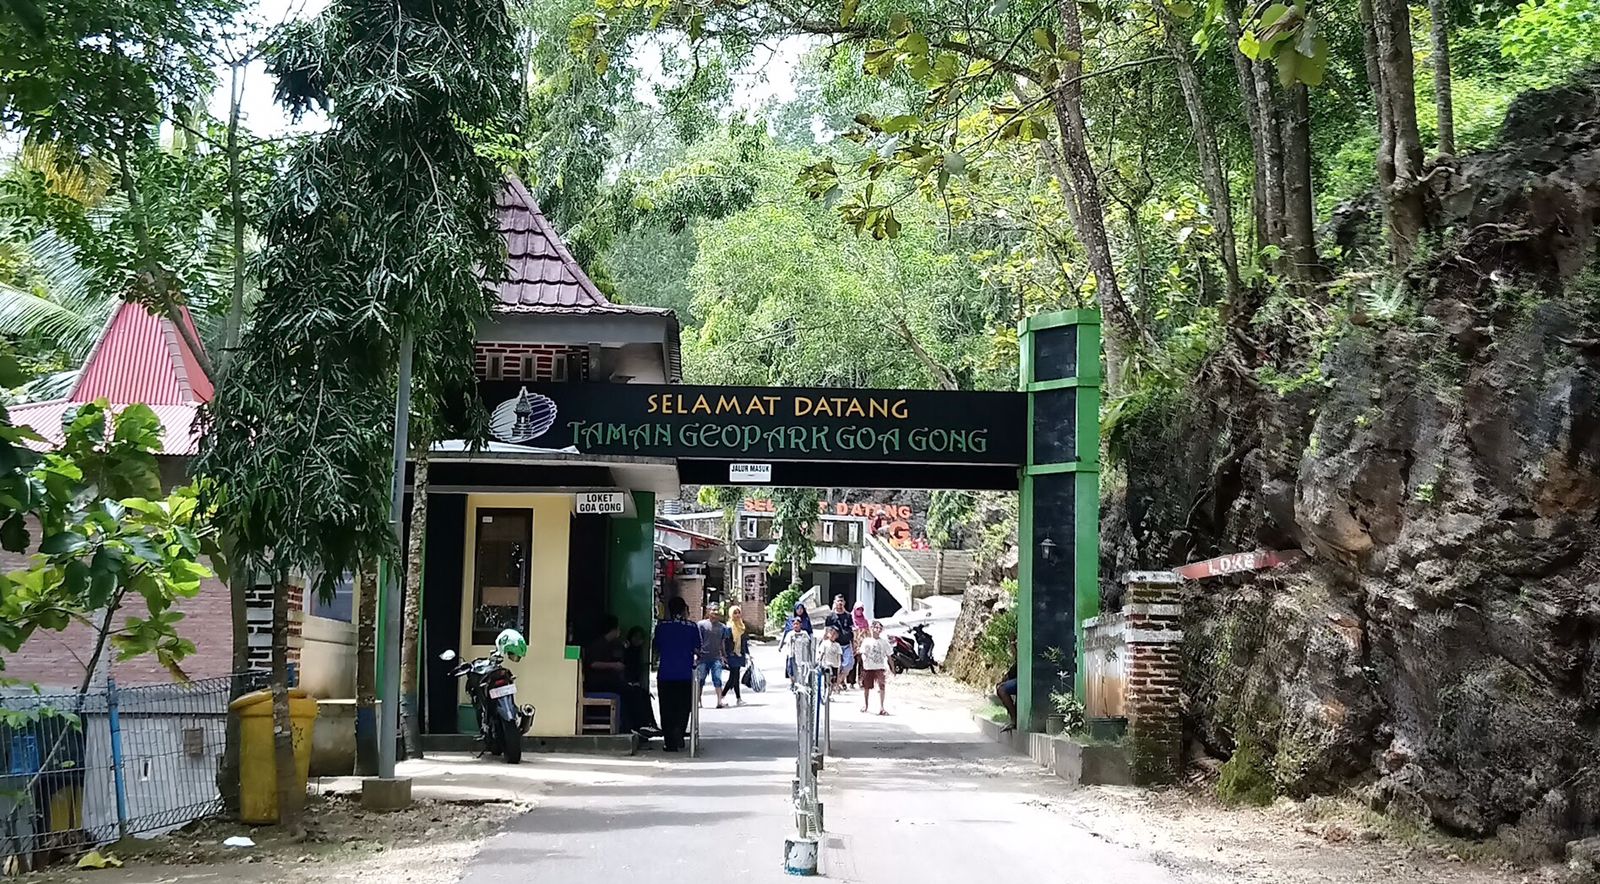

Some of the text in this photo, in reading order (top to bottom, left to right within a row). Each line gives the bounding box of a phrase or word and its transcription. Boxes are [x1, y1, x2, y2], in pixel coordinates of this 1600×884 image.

[647, 393, 909, 419] SELAMAT DATANG
[566, 420, 988, 455] TAMAN GEOPARK GOA GONG
[731, 464, 769, 473] JALUR MASUK
[586, 494, 614, 503] LOKET
[580, 503, 621, 512] GOA GONG
